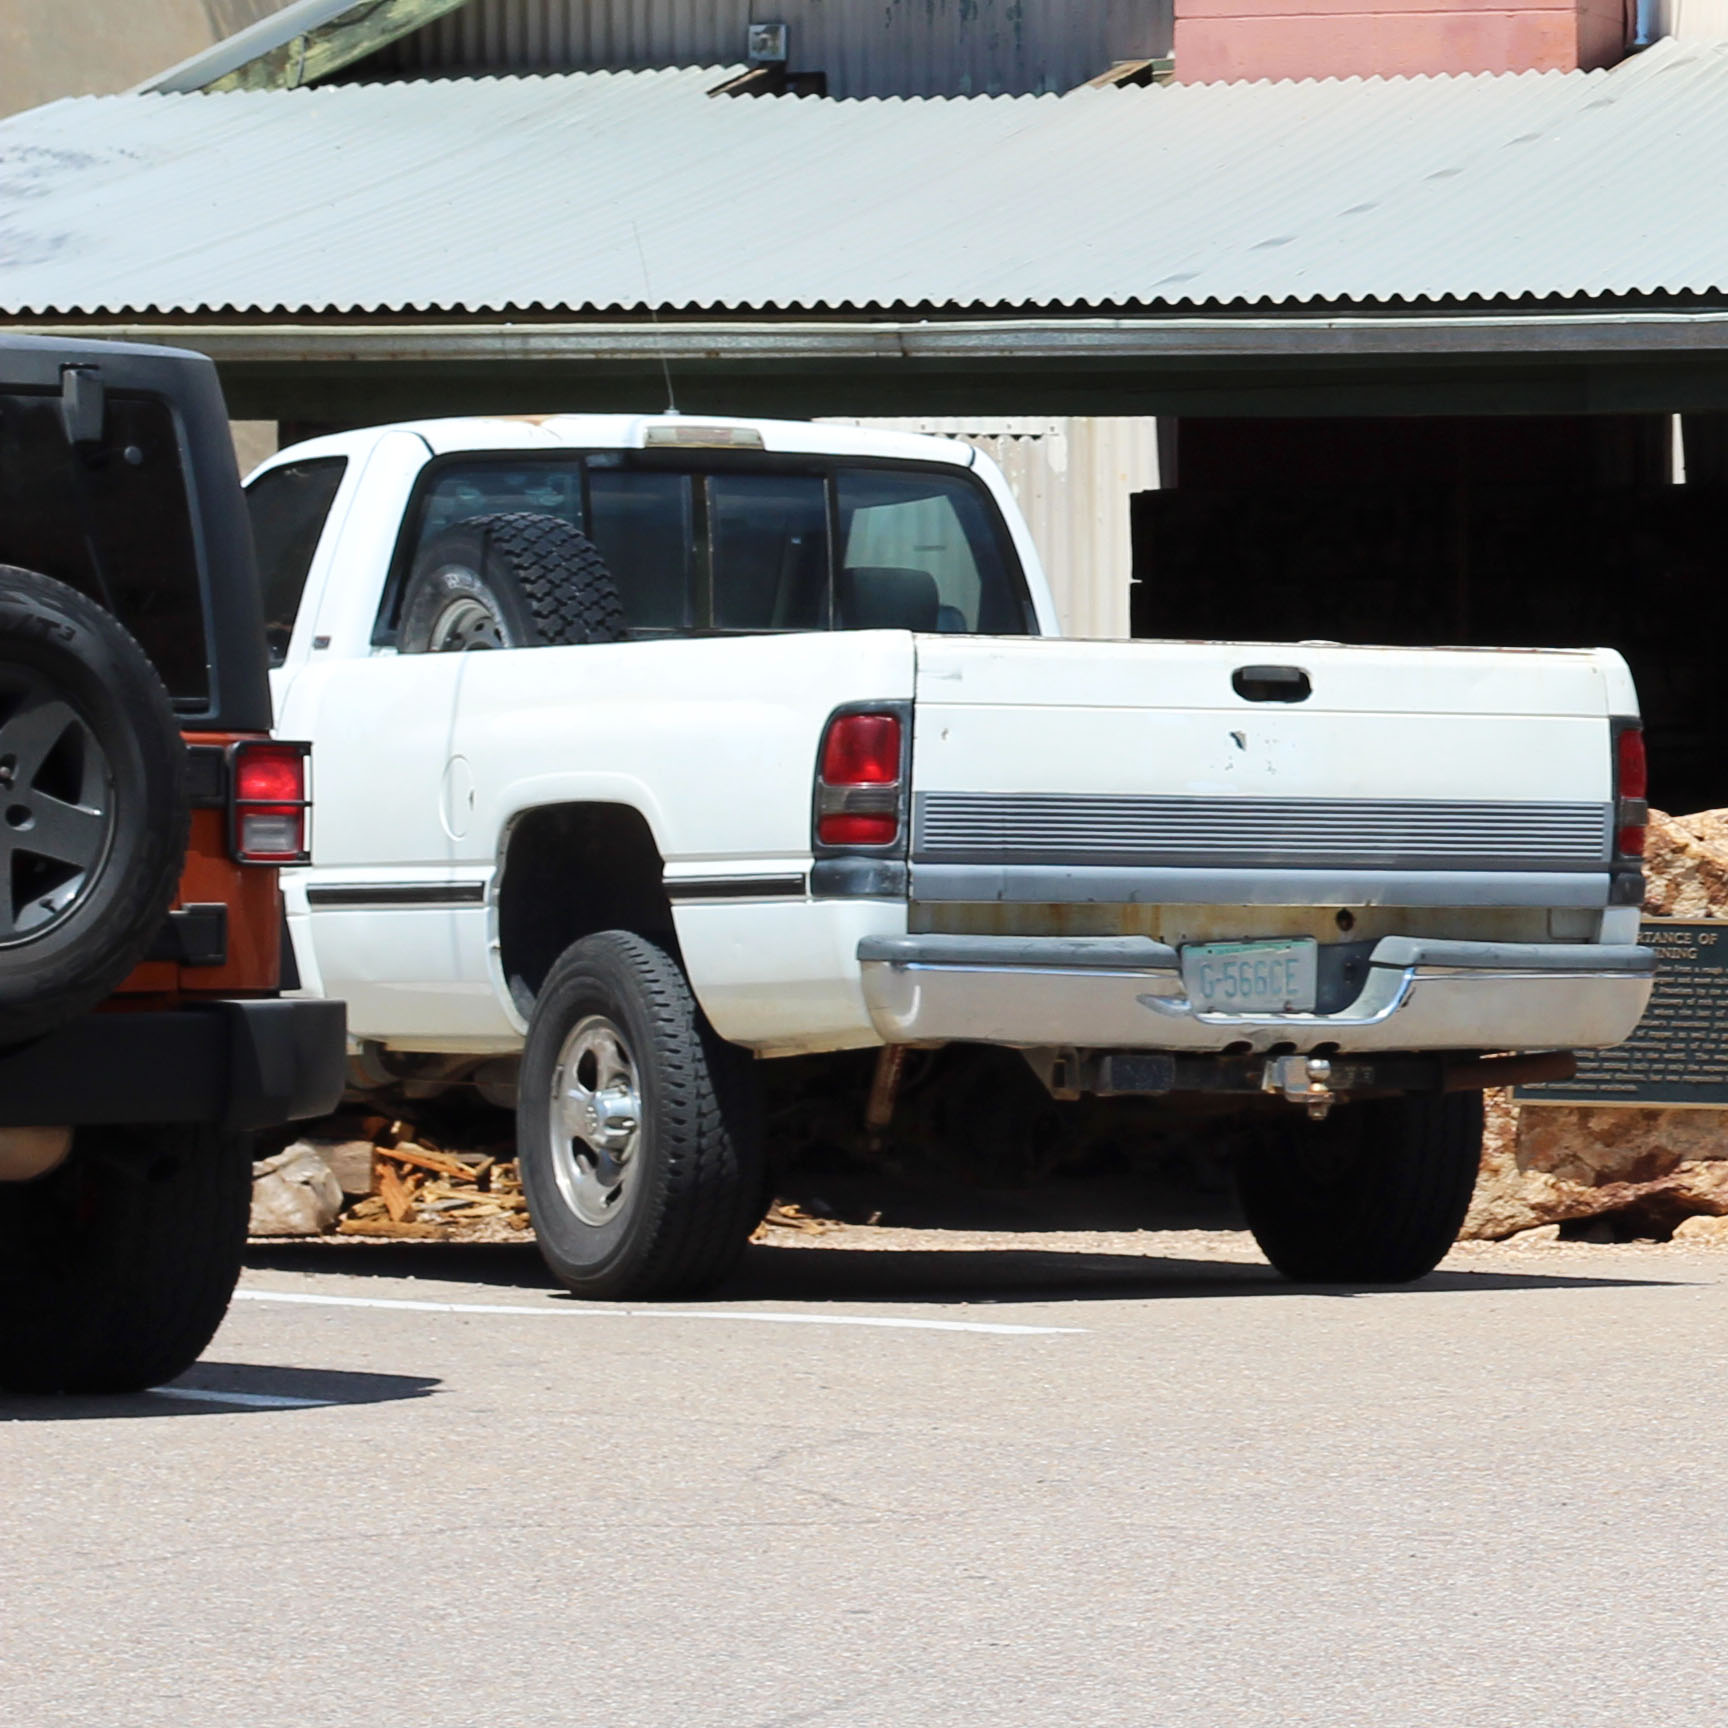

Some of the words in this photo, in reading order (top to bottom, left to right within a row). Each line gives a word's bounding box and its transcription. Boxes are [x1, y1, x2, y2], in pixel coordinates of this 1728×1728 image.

[1637, 932, 1692, 945] RTANCE
[1698, 932, 1719, 945] OF
[1655, 947, 1699, 959] INING
